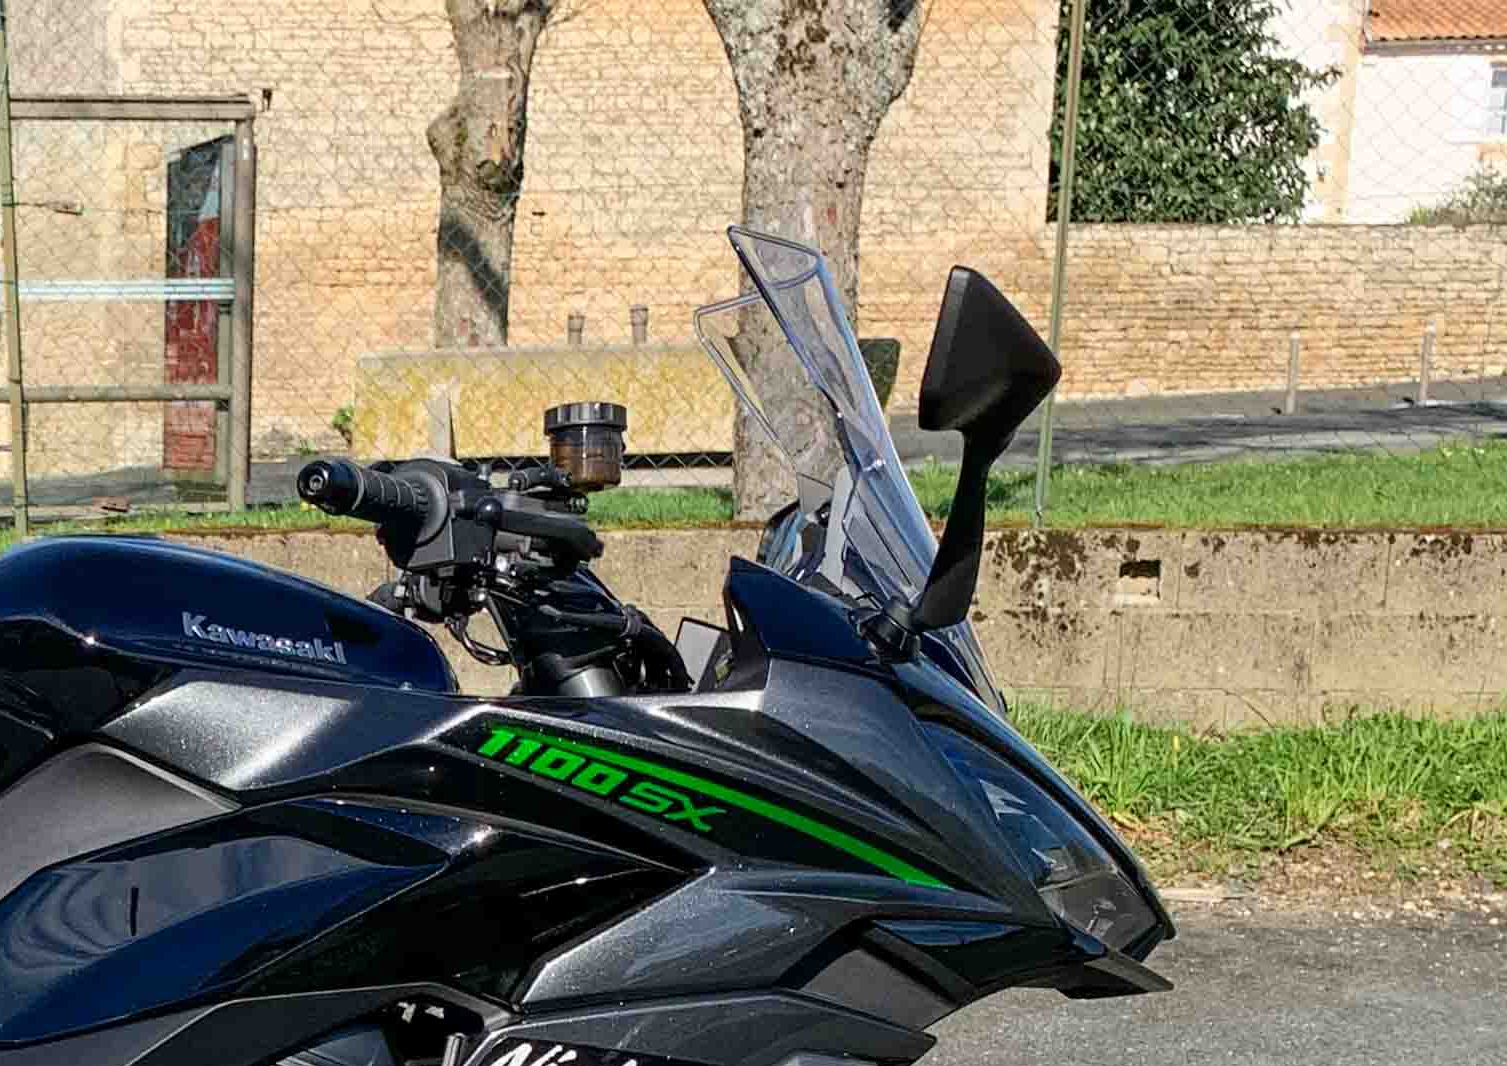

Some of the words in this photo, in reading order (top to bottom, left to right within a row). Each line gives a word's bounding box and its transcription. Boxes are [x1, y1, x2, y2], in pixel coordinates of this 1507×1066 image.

[182, 611, 347, 664] Kawasaki
[477, 728, 628, 796] 1100
[619, 781, 728, 832] SX
